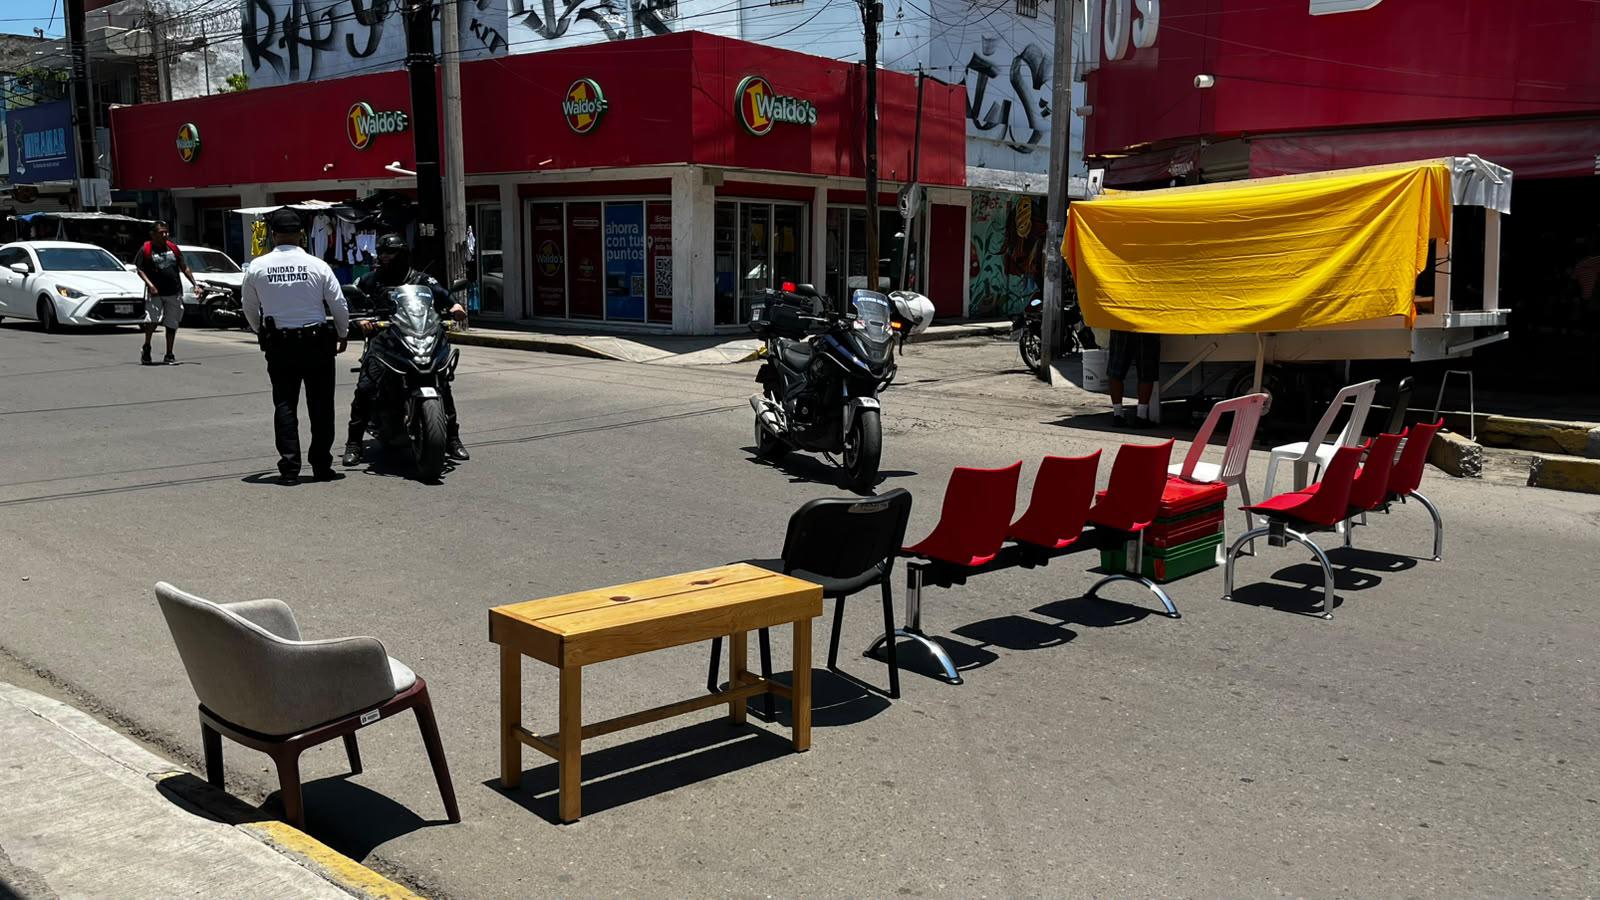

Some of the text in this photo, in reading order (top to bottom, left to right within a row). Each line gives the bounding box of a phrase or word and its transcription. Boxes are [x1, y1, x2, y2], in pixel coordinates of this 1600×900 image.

[562, 99, 603, 115] Waldo's
[756, 94, 817, 124] Waldo's
[357, 113, 404, 134] Waldo's
[606, 221, 639, 234] ahorra
[606, 237, 626, 247] con
[607, 249, 644, 262] puntos
[267, 265, 308, 274] UNIDAD DE
[267, 273, 308, 283] VIALIDAD
